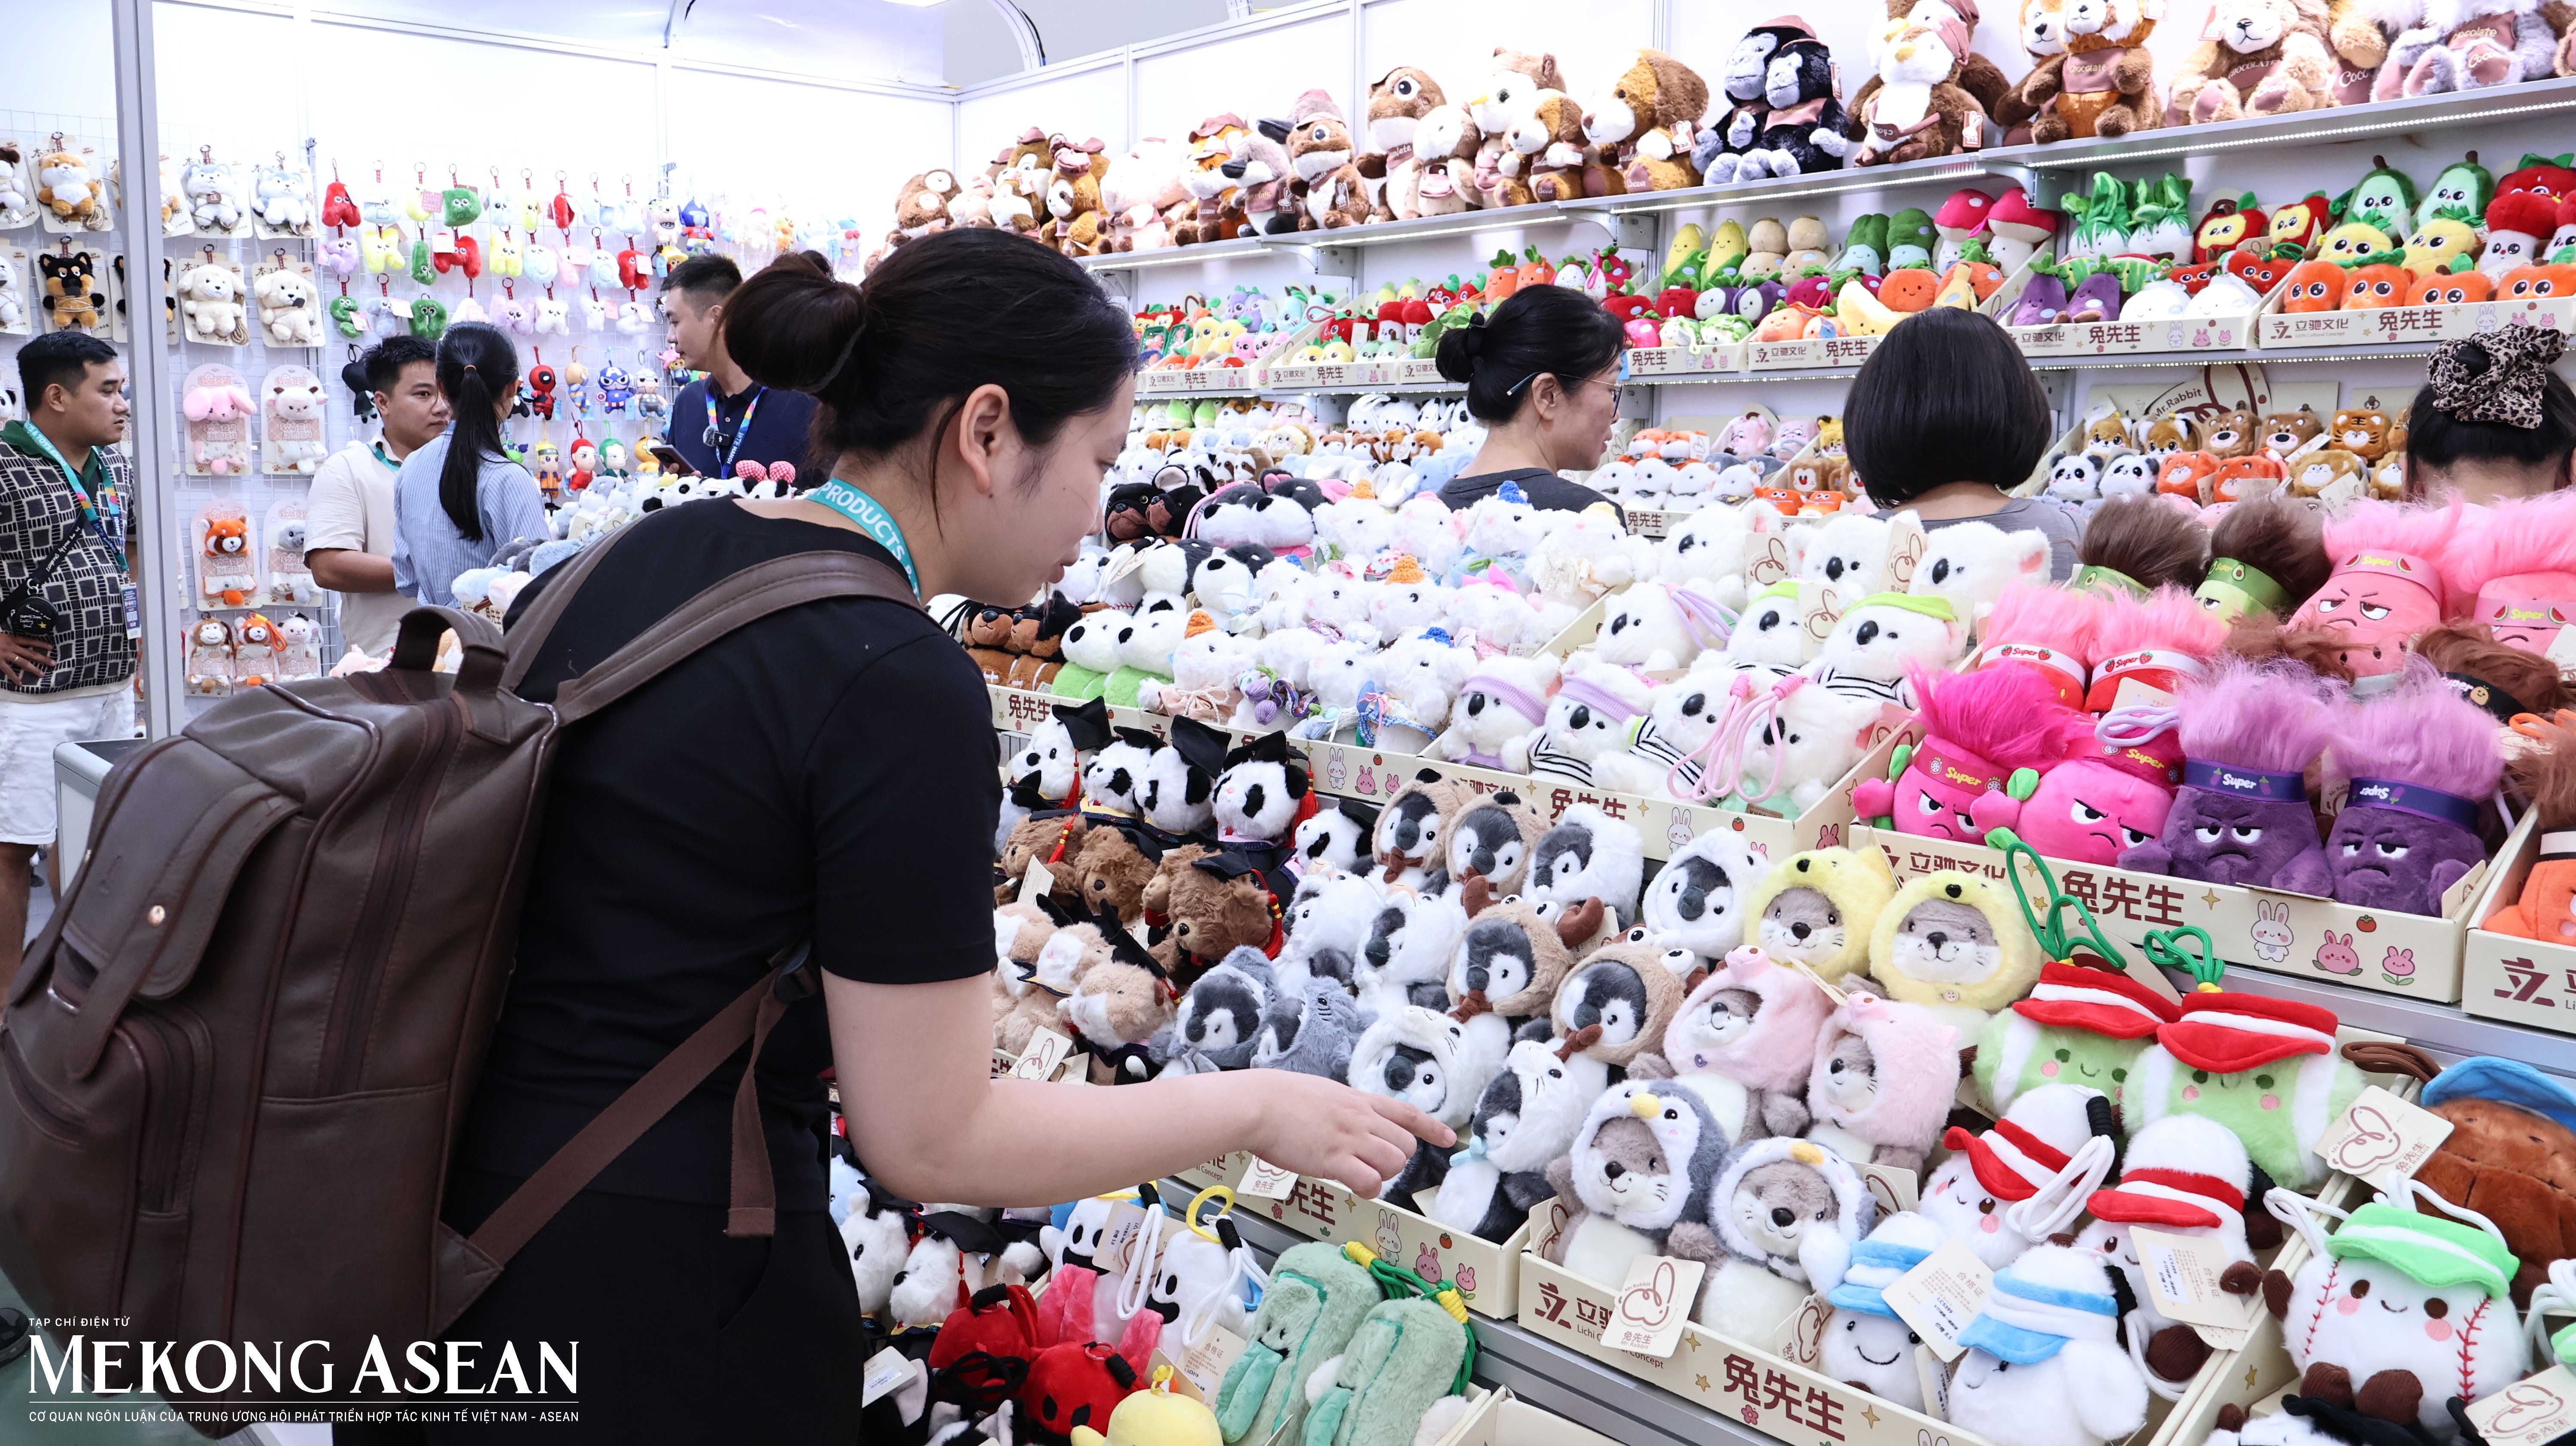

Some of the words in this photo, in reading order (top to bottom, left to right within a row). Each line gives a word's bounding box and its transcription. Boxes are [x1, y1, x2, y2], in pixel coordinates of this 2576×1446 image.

[1627, 179, 1646, 188] Cocoa
[2295, 319, 2348, 331] 立驰文化
[2379, 309, 2442, 331] 兔先生
[2022, 332, 2065, 342] 立驰文化
[2089, 325, 2141, 344] 兔先生
[1826, 340, 1868, 357] 兔先生
[1632, 351, 1667, 366] 兔先生
[1185, 372, 1206, 384] 兔先生
[1317, 366, 1343, 379] 兔先生
[2155, 388, 2202, 418] Mr.Rabbit
[50, 449, 67, 467] EXPO
[726, 445, 738, 465] HANOI
[819, 481, 905, 561] PRODUCTS
[1628, 512, 1662, 528] 兔先生
[2362, 556, 2394, 567] Super
[2510, 608, 2544, 621] Super
[2012, 647, 2038, 657] Super
[2116, 656, 2138, 668] Super
[2125, 748, 2165, 770] Super
[1945, 766, 1982, 787] Super
[2222, 773, 2257, 791] Super
[2359, 785, 2390, 800] Super
[2061, 869, 2184, 927] 兔先生
[2331, 1131, 2357, 1154] Mr.Rabbit
[2396, 1141, 2426, 1172] 兔先生
[2403, 1145, 2430, 1174] Mr.Rabbit
[1201, 1166, 1223, 1182] Concept
[1255, 1179, 1276, 1190] 兔先生
[1537, 1229, 1554, 1251] Mr.Rabbit
[2168, 1255, 2177, 1274] LC5399
[1625, 1282, 1651, 1292] Mr.Rabbit
[1956, 1271, 1985, 1298] 合格证
[2203, 1267, 2221, 1299] 合格证
[1937, 1297, 1953, 1314] LC5399
[1577, 1324, 1595, 1340] Lichi
[1622, 1331, 1653, 1345] 兔先生
[1944, 1332, 1953, 1340] 8.5
[1204, 1343, 1224, 1359] 合格证
[1620, 1340, 1649, 1350] Mr.Rabbit
[1187, 1368, 1199, 1378] LC5319
[1724, 1353, 1846, 1442] 兔先生
